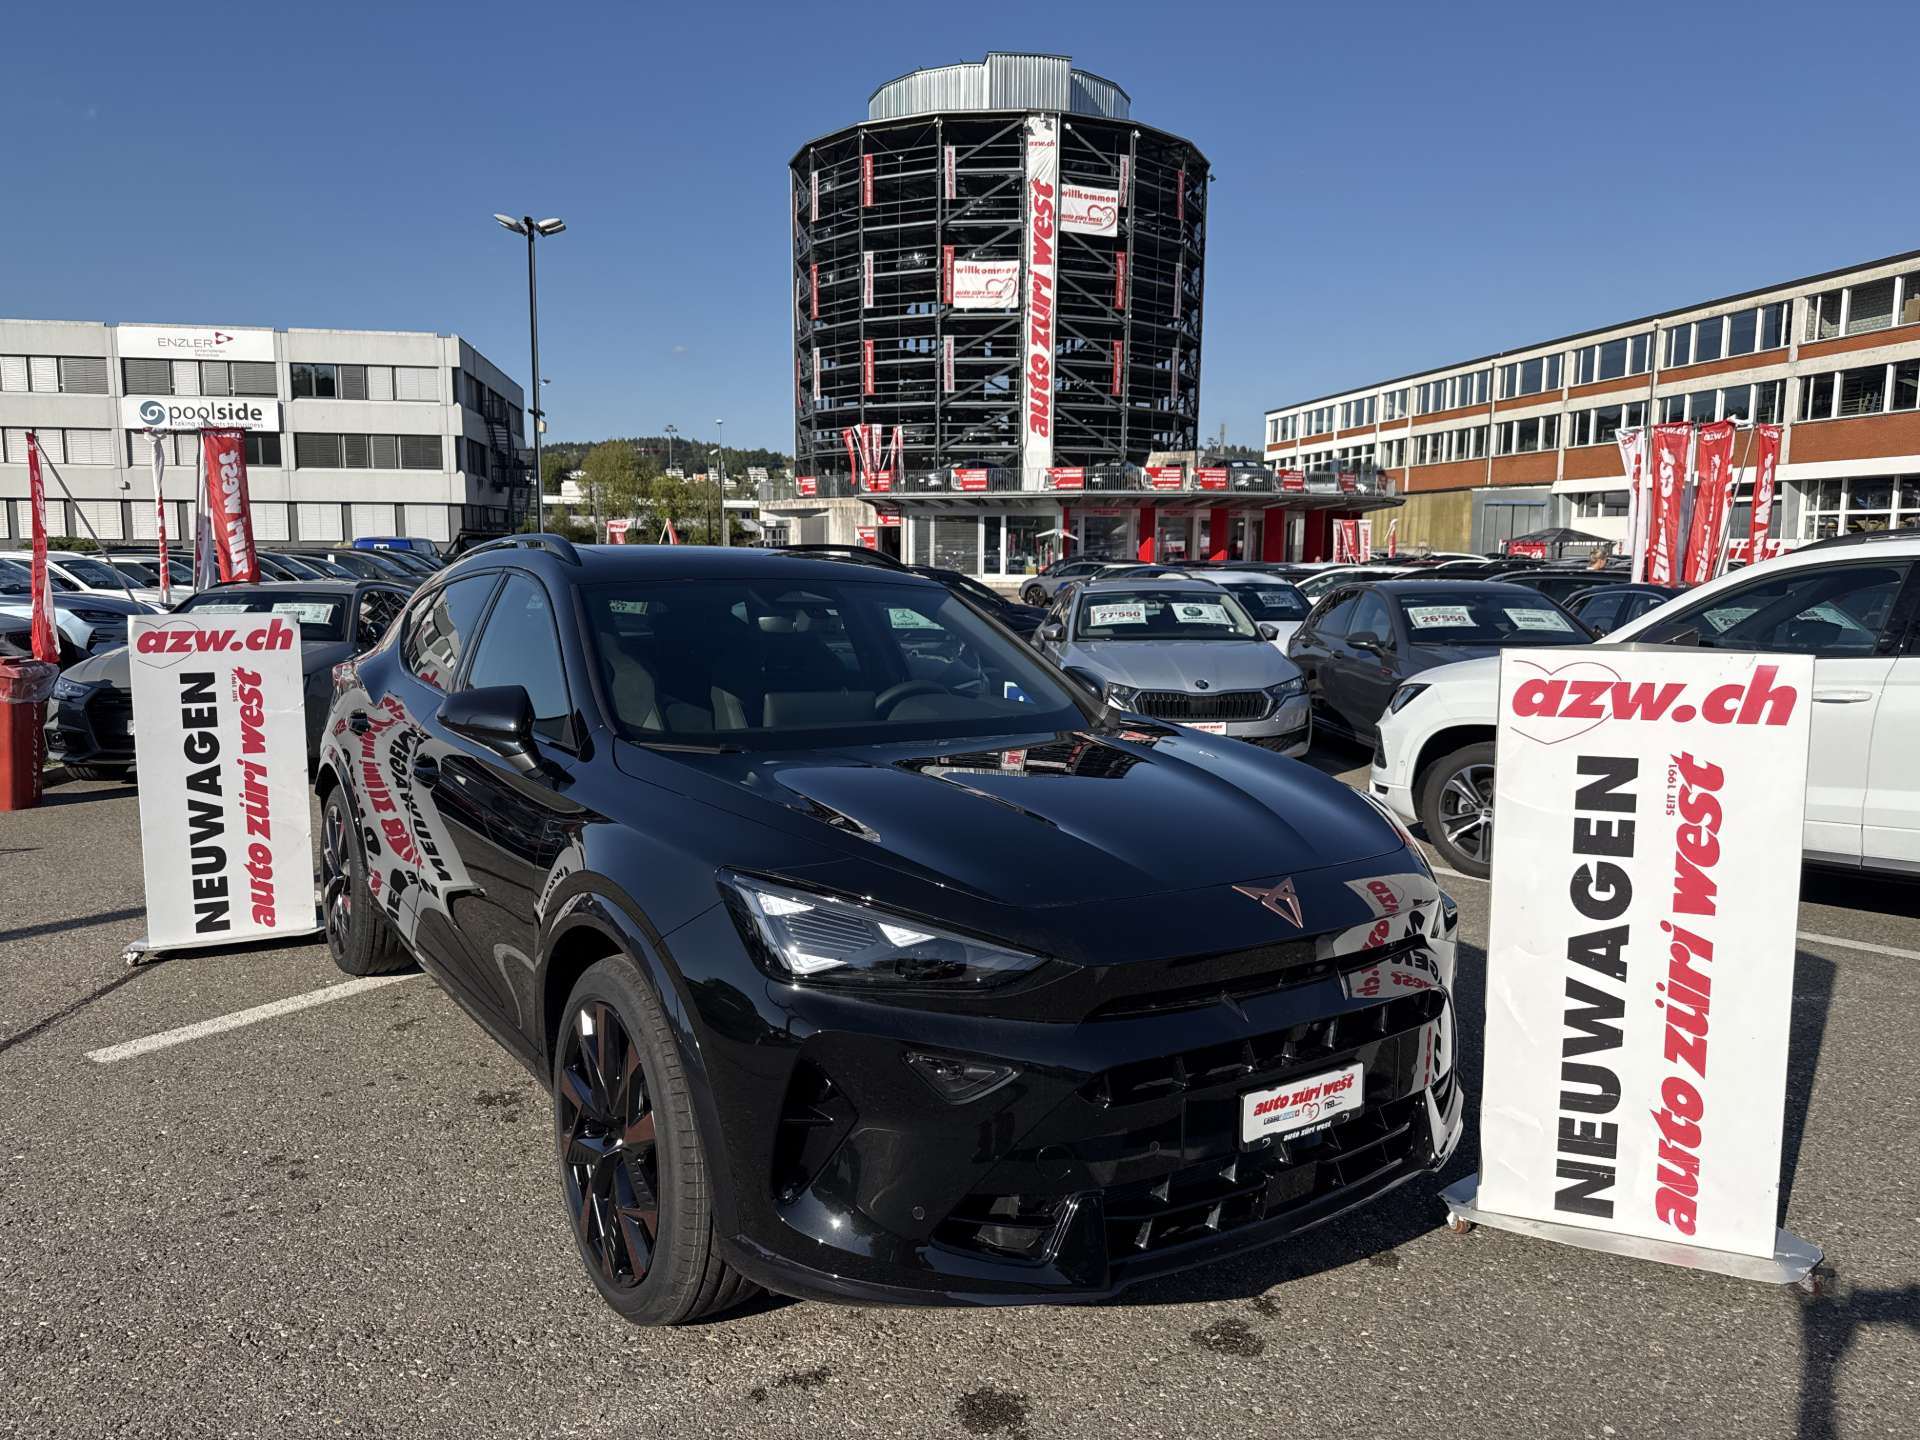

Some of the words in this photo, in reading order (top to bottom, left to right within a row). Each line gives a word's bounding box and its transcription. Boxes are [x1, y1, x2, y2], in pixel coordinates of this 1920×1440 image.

[1028, 139, 1056, 147] azw.ch
[1031, 178, 1053, 265] west
[1060, 188, 1116, 202] willkommen
[157, 337, 213, 349] ENZLER
[1028, 269, 1052, 349] züri
[168, 401, 263, 426] poolside
[1027, 353, 1050, 438] auto
[1659, 448, 1676, 517] est
[137, 619, 293, 654] azw.ch
[233, 666, 266, 754] west
[1511, 665, 1797, 727] azw.ch
[180, 671, 231, 934] NEUWAGEN
[238, 758, 270, 840] züri
[1666, 787, 1676, 816] SEIT
[1667, 762, 1677, 784] 1991
[1671, 751, 1725, 916] west
[243, 843, 276, 928] auto
[1555, 755, 1639, 1219] NEUWAGEN
[1655, 920, 1714, 1078] züri
[1254, 1094, 1289, 1116] auto
[1290, 1083, 1323, 1105] züri
[1323, 1074, 1354, 1095] west
[1283, 1131, 1300, 1141] auto
[1300, 1126, 1316, 1137] züri
[1316, 1121, 1332, 1131] west
[1651, 1076, 1705, 1237] auto
